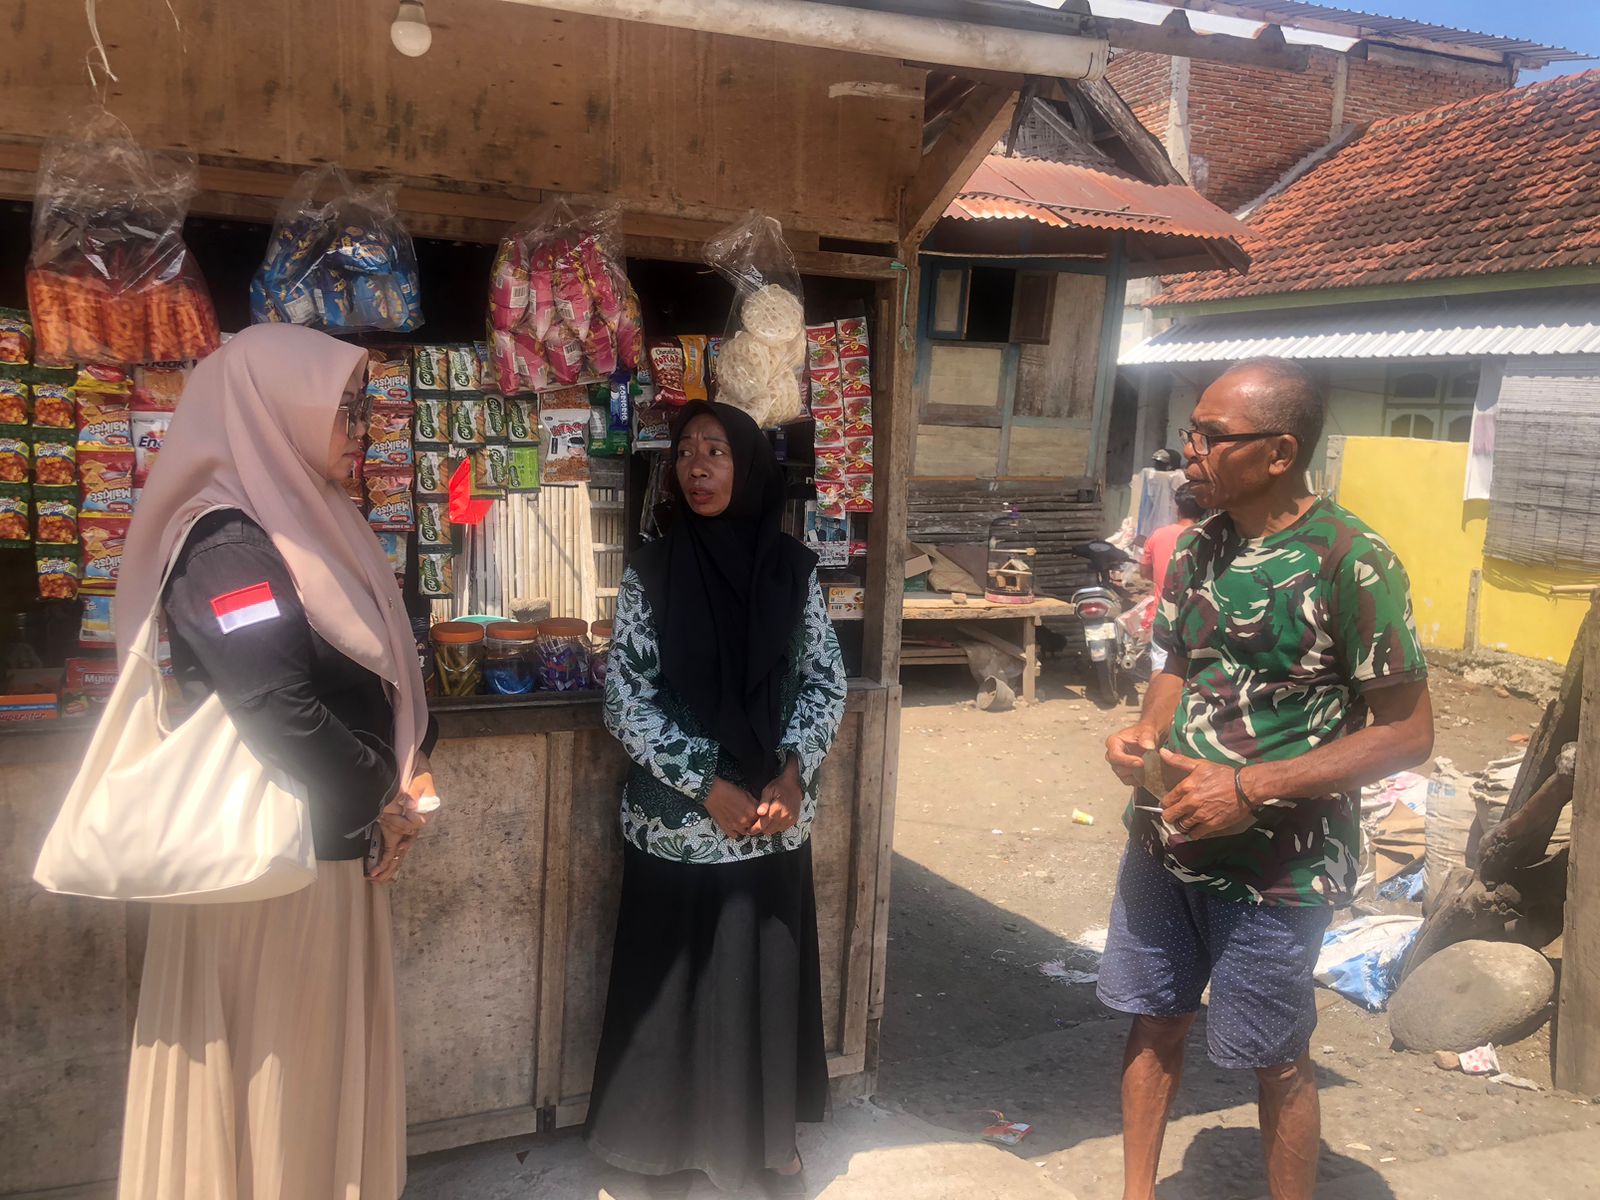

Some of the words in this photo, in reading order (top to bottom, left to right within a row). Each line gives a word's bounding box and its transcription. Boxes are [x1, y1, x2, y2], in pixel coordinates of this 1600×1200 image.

[375, 374, 409, 390] Malkist
[89, 421, 129, 436] Malkist
[375, 439, 409, 454] Malkist
[91, 488, 131, 503] Malkist
